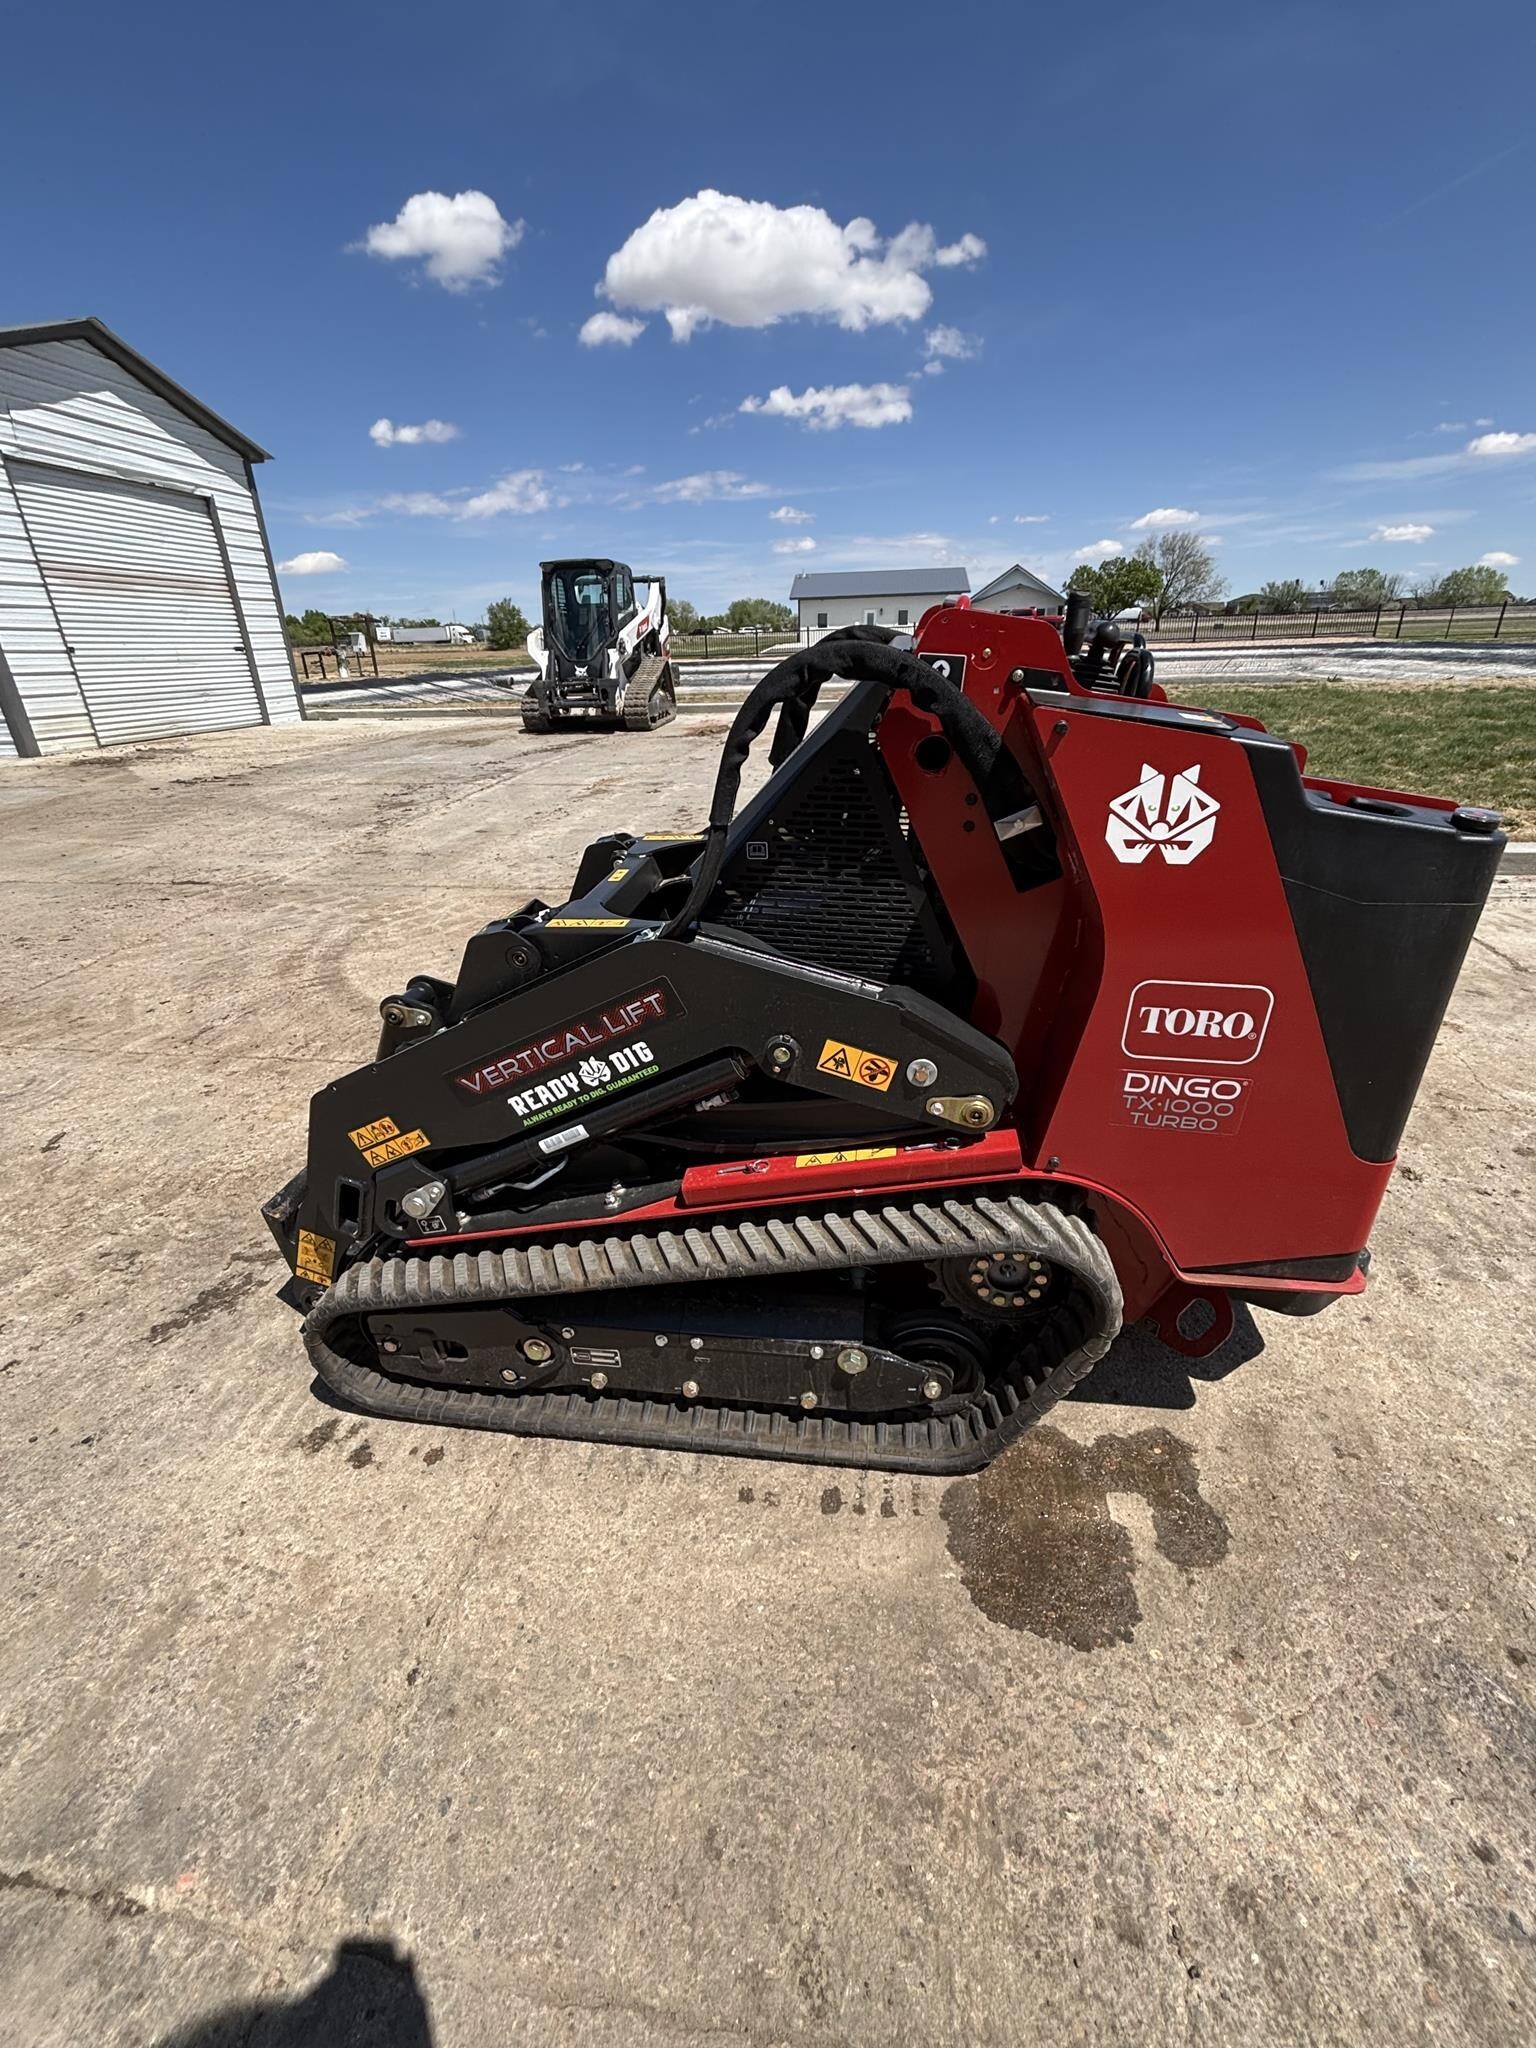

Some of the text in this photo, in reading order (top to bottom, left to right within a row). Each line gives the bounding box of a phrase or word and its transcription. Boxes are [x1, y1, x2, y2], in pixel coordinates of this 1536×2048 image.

[461, 992, 664, 1092] VERTICAL LIFT
[507, 1041, 654, 1116] READY DIG
[523, 1109, 553, 1127] ALWAYS
[553, 1098, 578, 1114] READY
[579, 1094, 590, 1103] TO
[606, 1065, 659, 1091] GUARANTEED
[1130, 1112, 1218, 1131] TURBO
